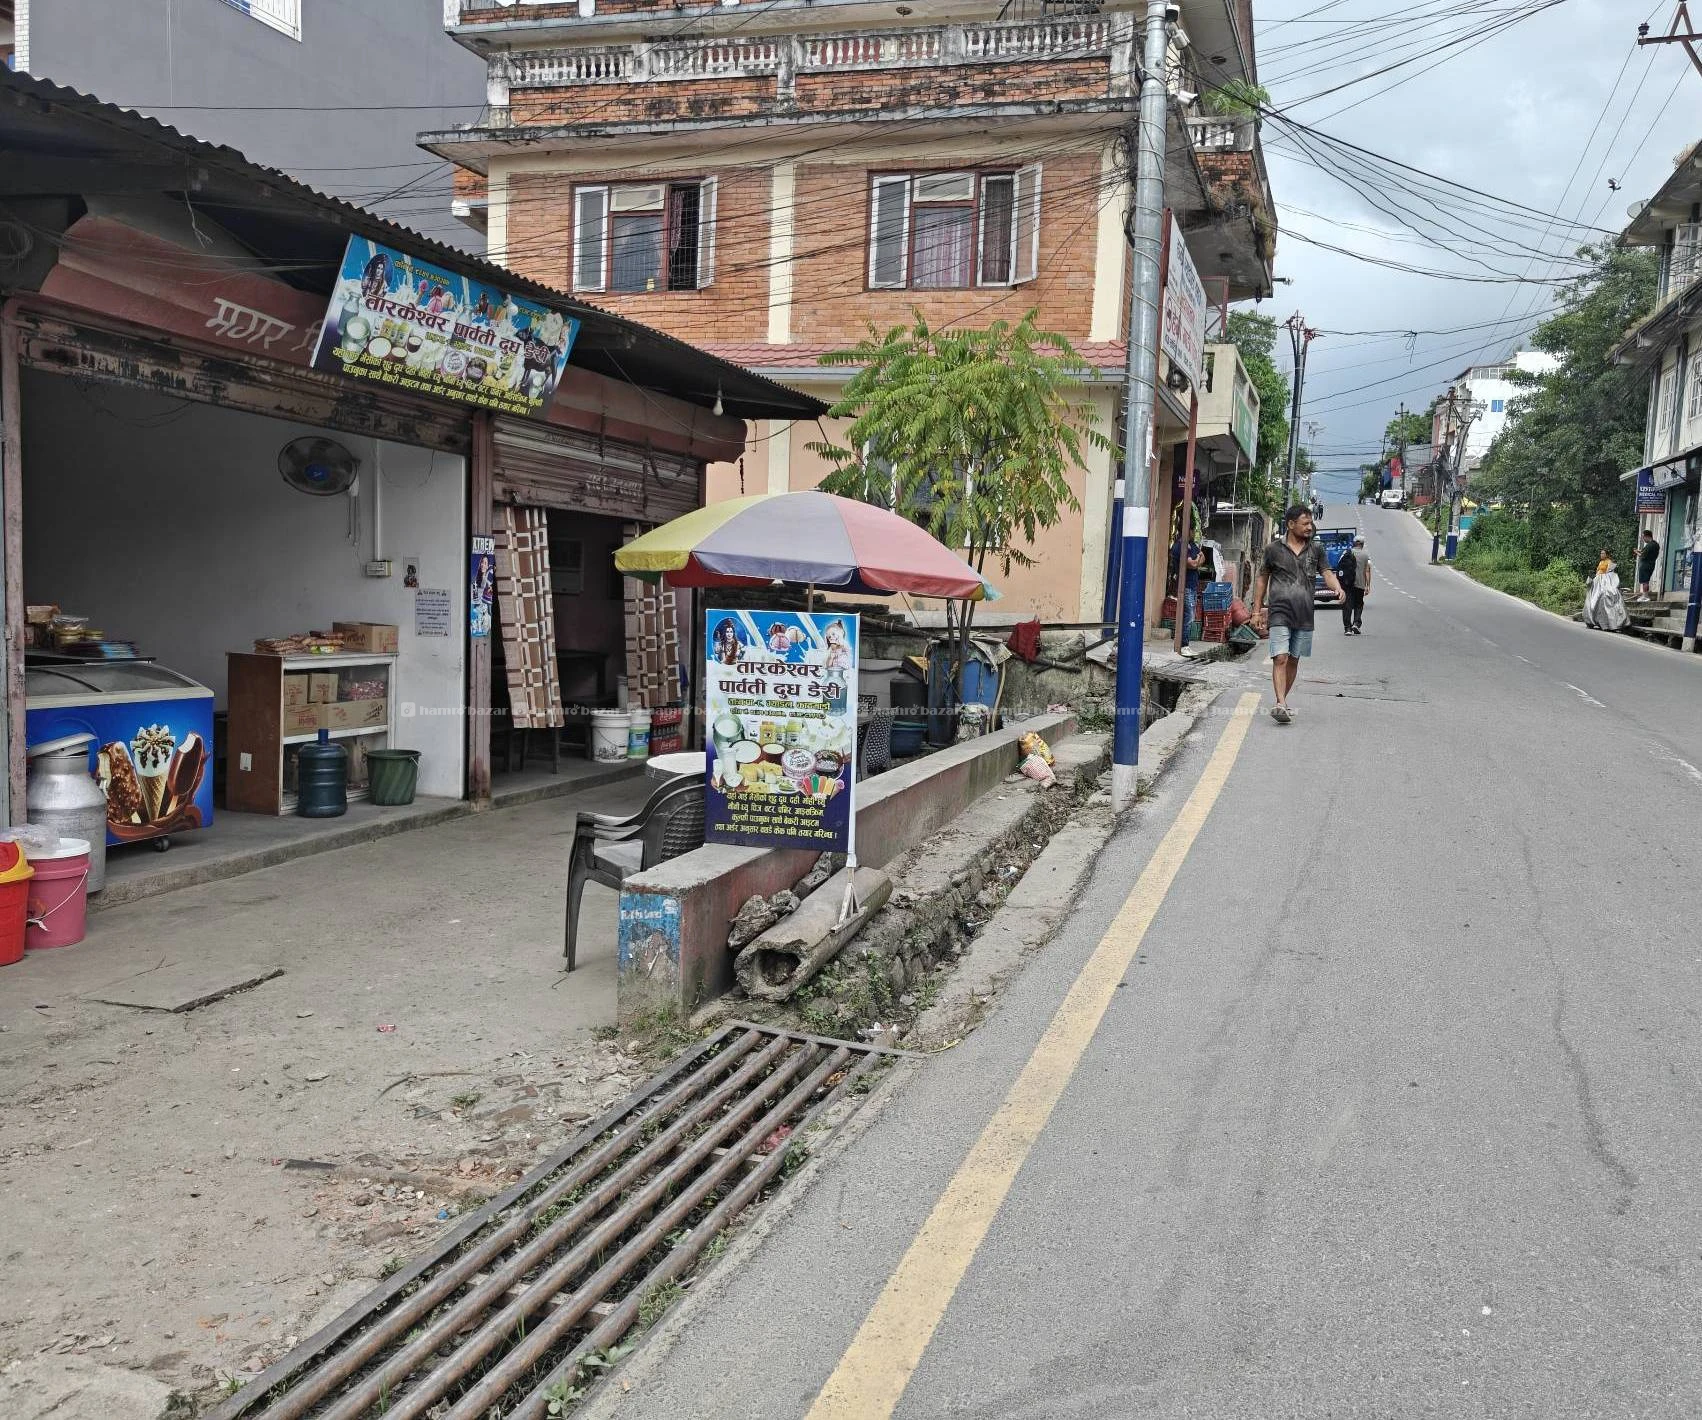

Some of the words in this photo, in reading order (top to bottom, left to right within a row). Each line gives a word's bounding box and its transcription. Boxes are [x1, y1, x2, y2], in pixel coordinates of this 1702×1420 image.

[365, 294, 450, 332] तारकेश्वर
[454, 321, 497, 347] पार्वती
[499, 336, 522, 358] दुध
[737, 659, 823, 678] तारकेश्वर
[719, 678, 767, 694] पार्वती
[774, 683, 801, 698] दुध
[808, 681, 841, 699] डेरी
